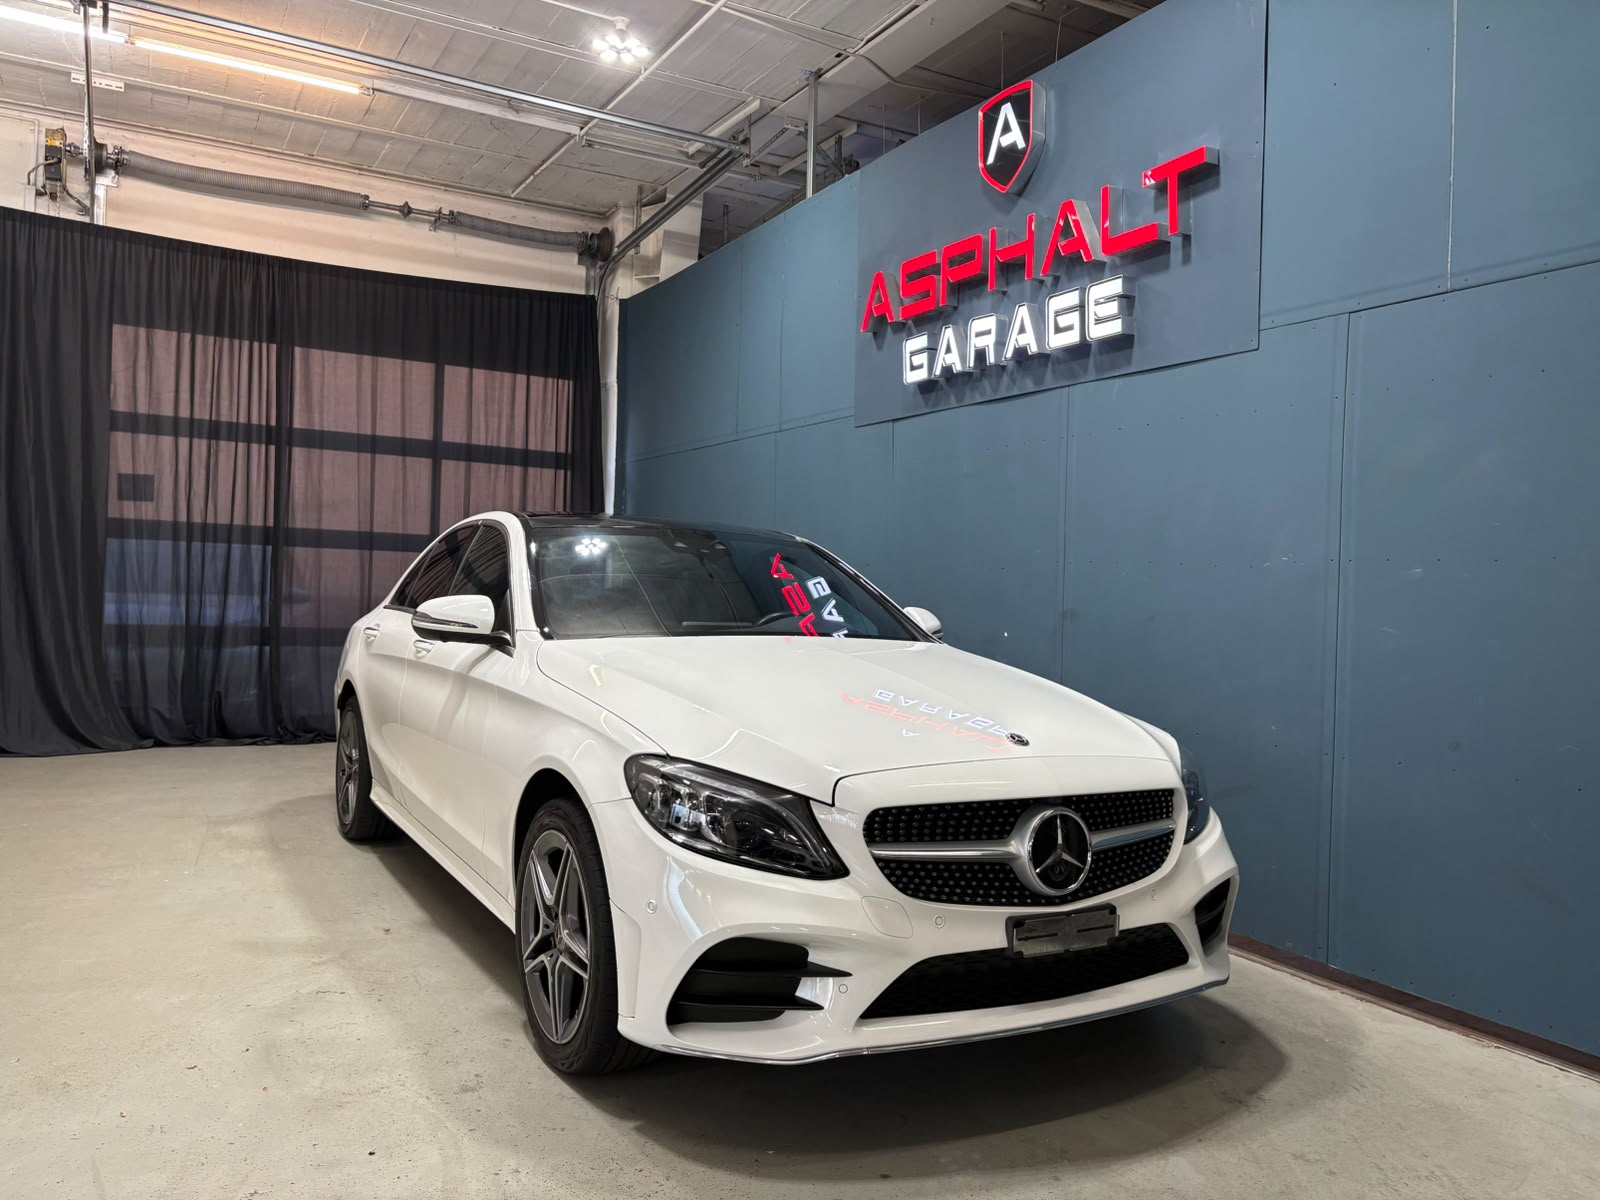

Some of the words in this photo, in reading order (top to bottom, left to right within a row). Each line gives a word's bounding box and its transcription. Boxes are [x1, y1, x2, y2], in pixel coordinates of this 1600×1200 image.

[985, 102, 1026, 165] A
[861, 146, 1210, 332] ASPHALT
[903, 275, 1124, 386] GARAGE
